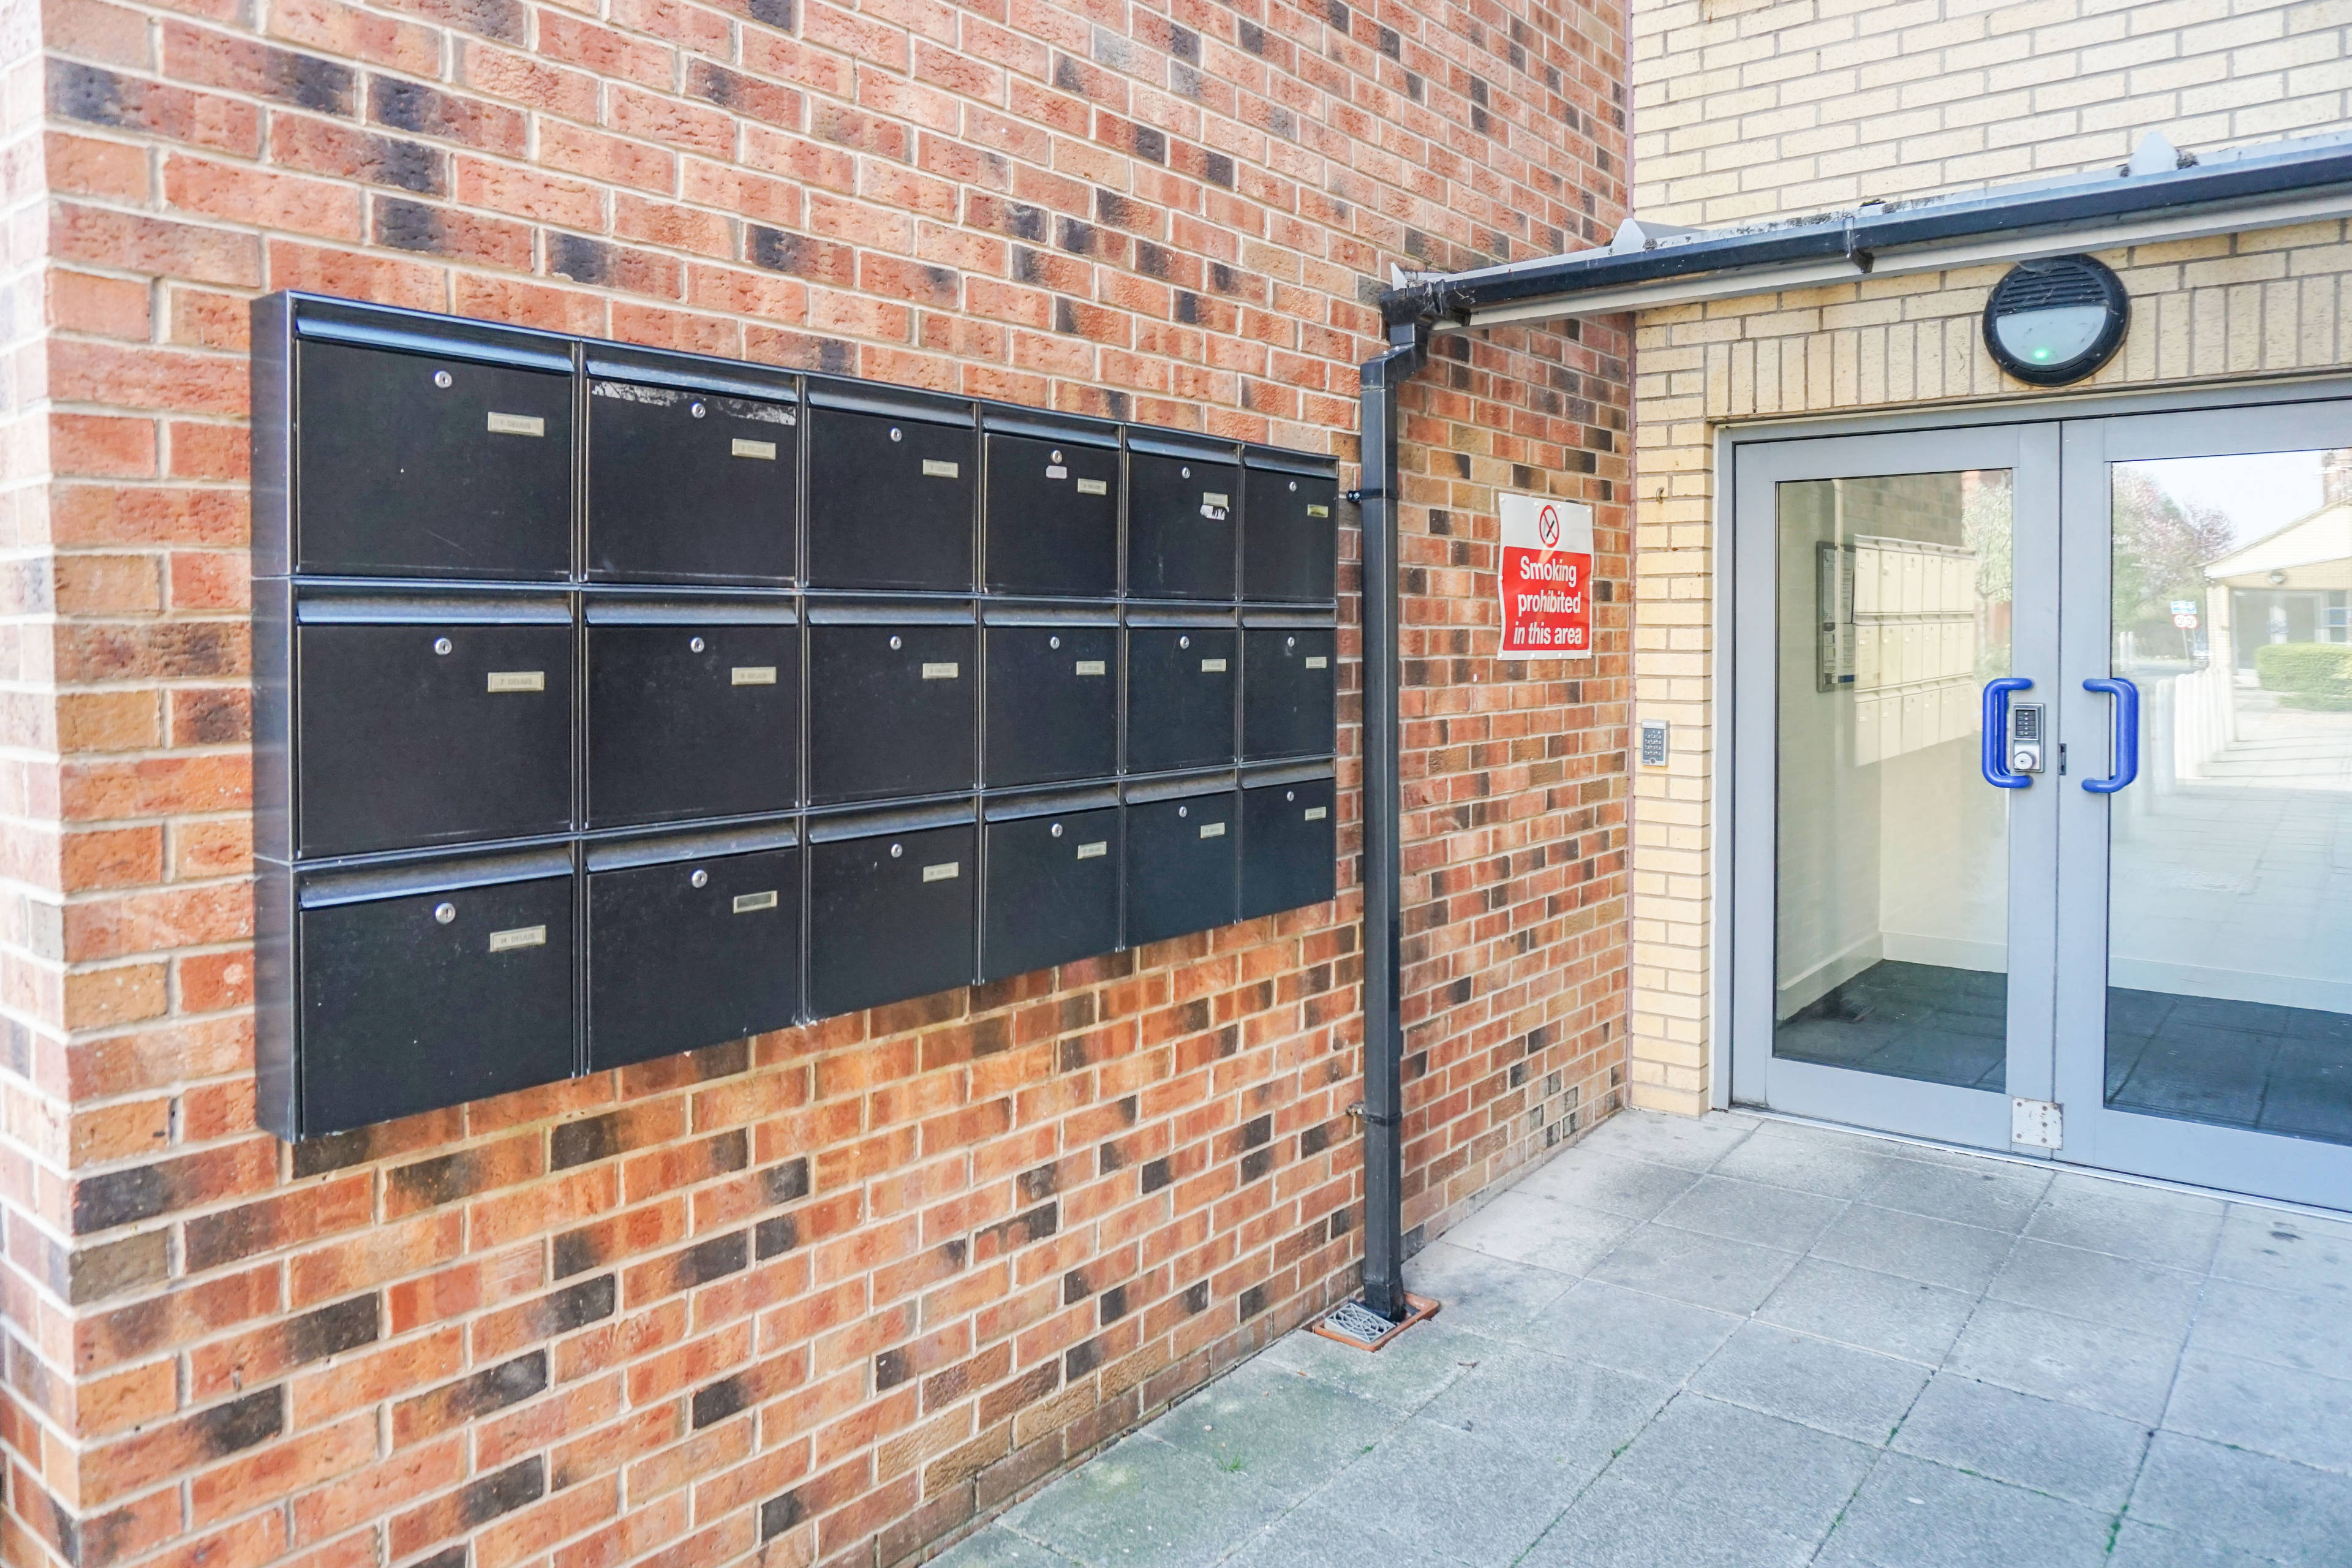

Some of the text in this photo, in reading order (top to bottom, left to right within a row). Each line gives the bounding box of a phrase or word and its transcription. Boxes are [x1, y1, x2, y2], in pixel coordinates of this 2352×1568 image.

[1520, 556, 1577, 588] Smoking
[1517, 590, 1581, 617] prohibited
[1513, 621, 1582, 644] in this area
